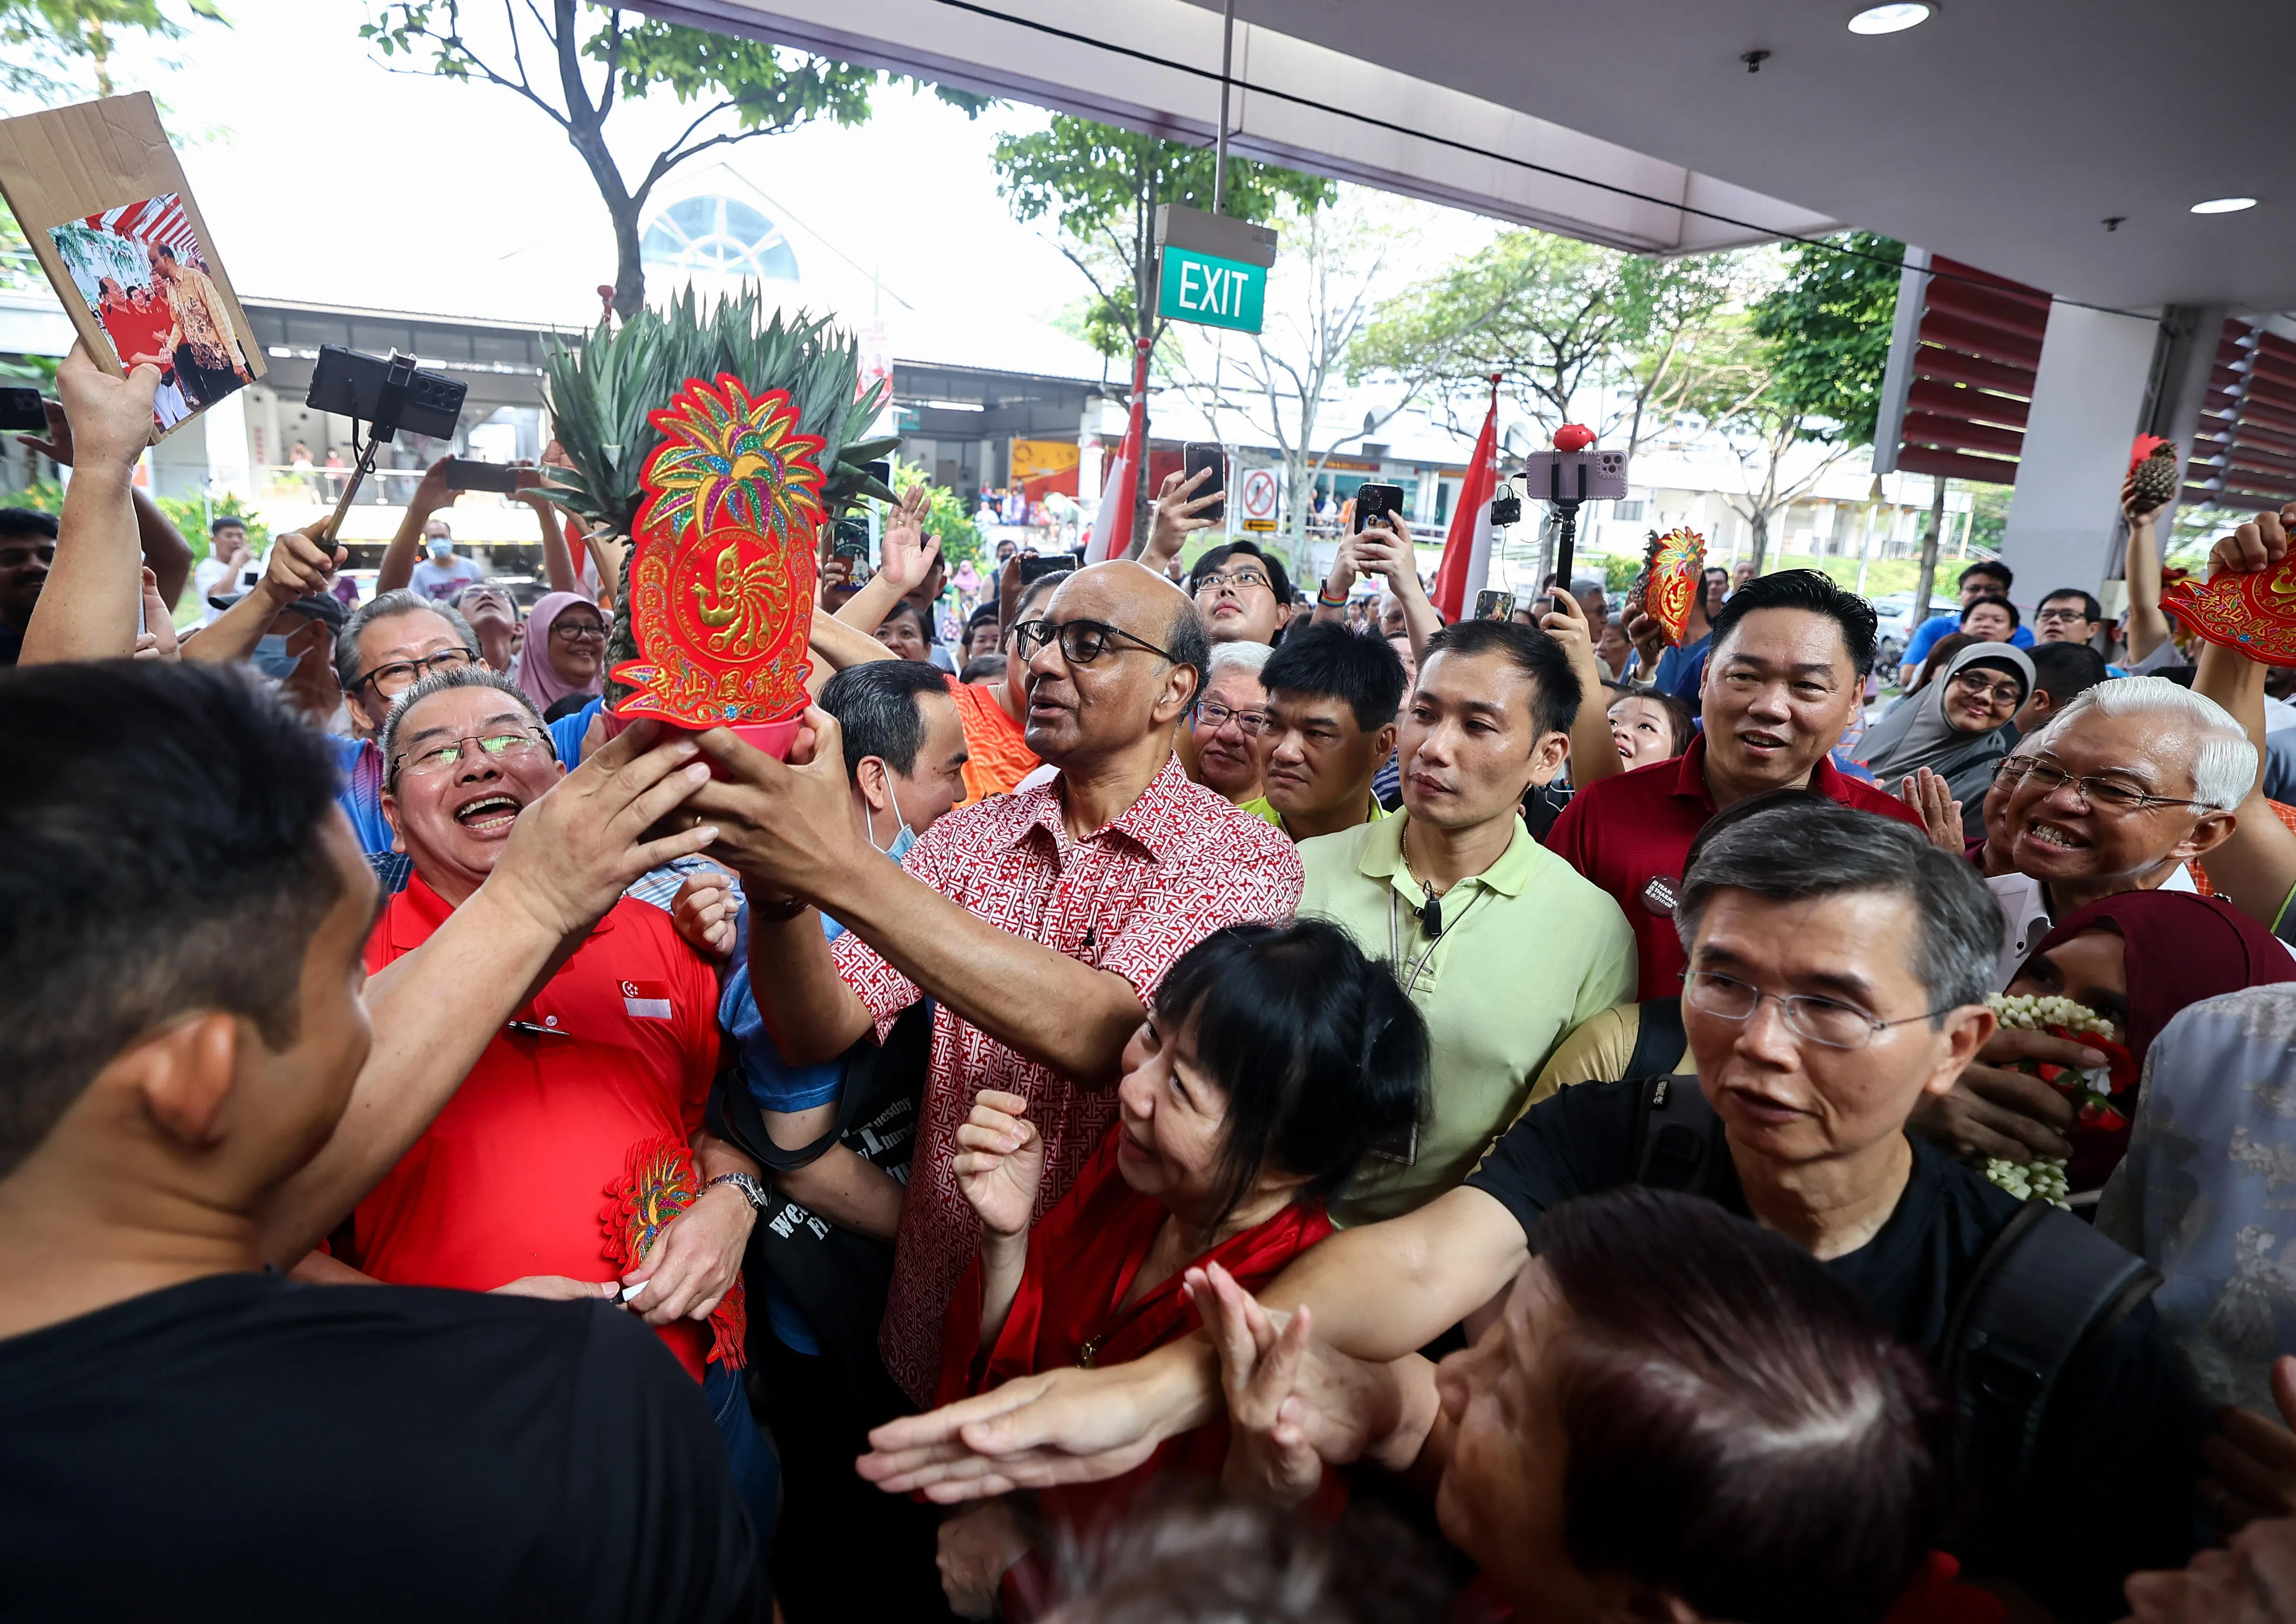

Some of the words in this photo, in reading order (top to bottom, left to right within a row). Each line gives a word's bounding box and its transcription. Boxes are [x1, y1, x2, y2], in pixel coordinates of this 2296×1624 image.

[1179, 260, 1249, 317] EXIT
[719, 531, 769, 553] ASSOCIATION
[1654, 888, 1678, 906] THARMA
[1658, 883, 1673, 896] TEAM
